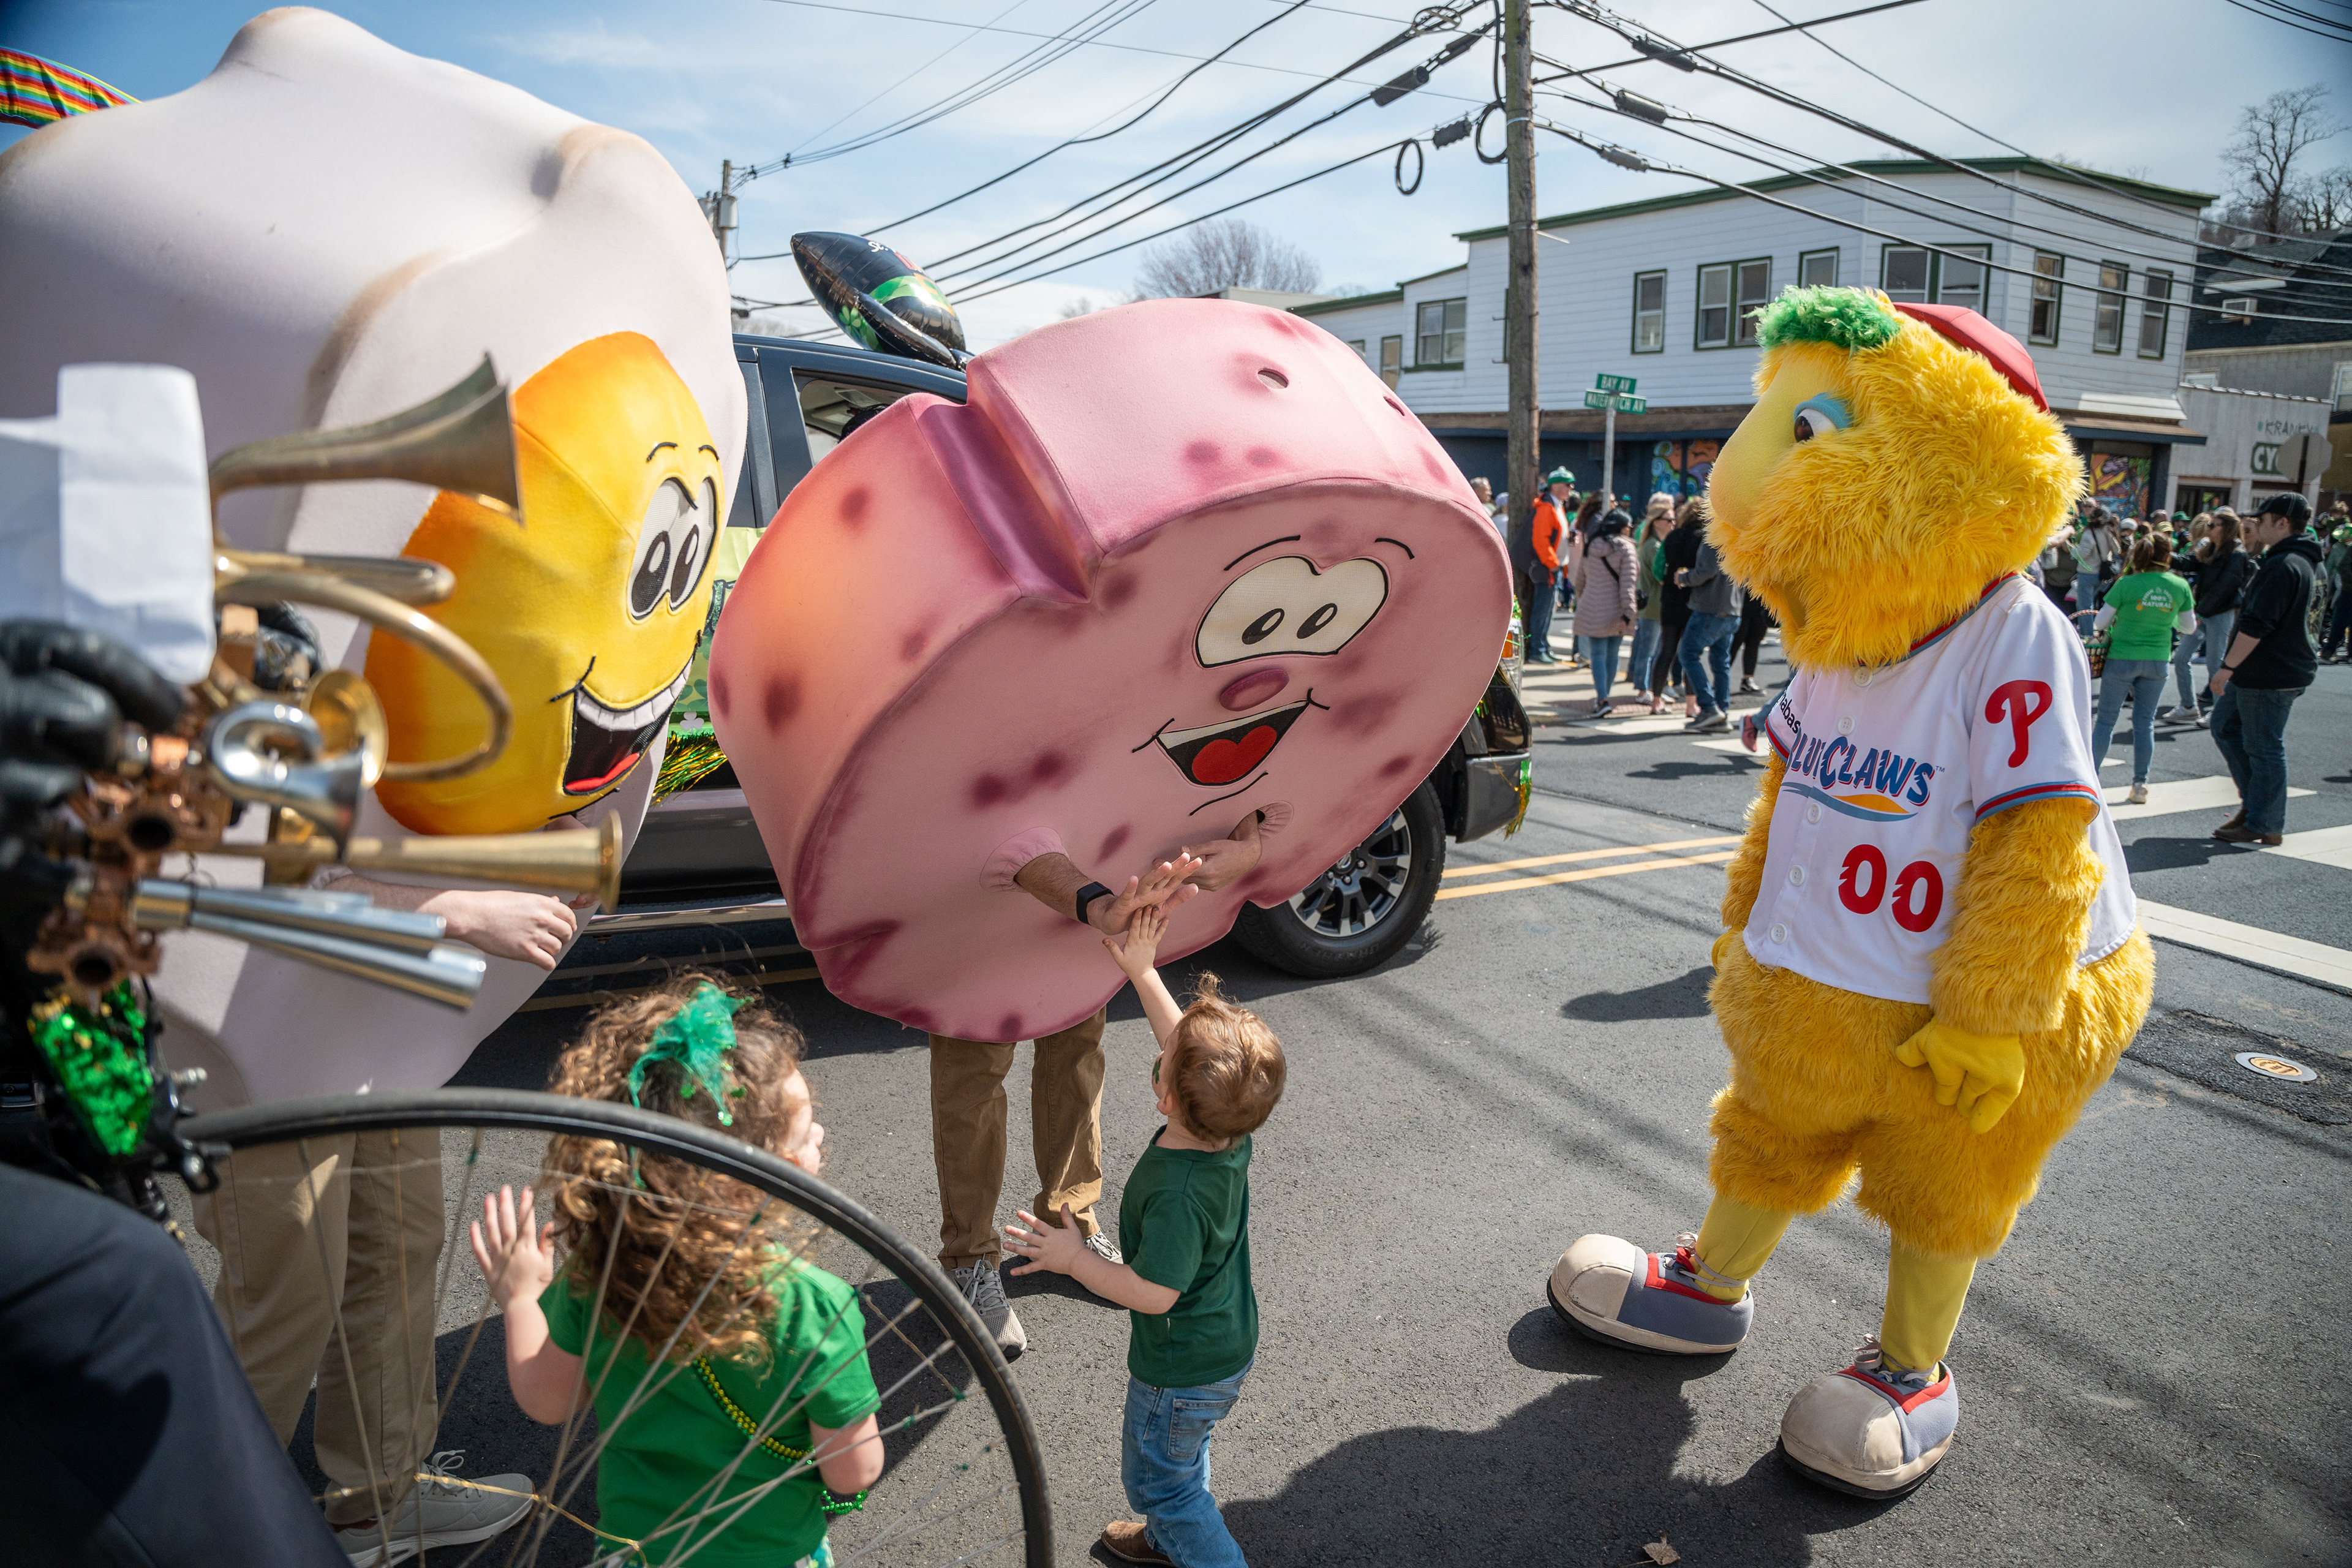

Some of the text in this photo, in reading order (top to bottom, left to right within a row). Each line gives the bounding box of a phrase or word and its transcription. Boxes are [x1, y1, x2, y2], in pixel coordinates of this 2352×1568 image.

[1601, 376, 1631, 392] BAY AV
[1587, 393, 1645, 412] WATERWITCH AV
[2253, 445, 2279, 471] CY
[1985, 679, 2052, 768] P
[1838, 844, 1943, 933] 00
